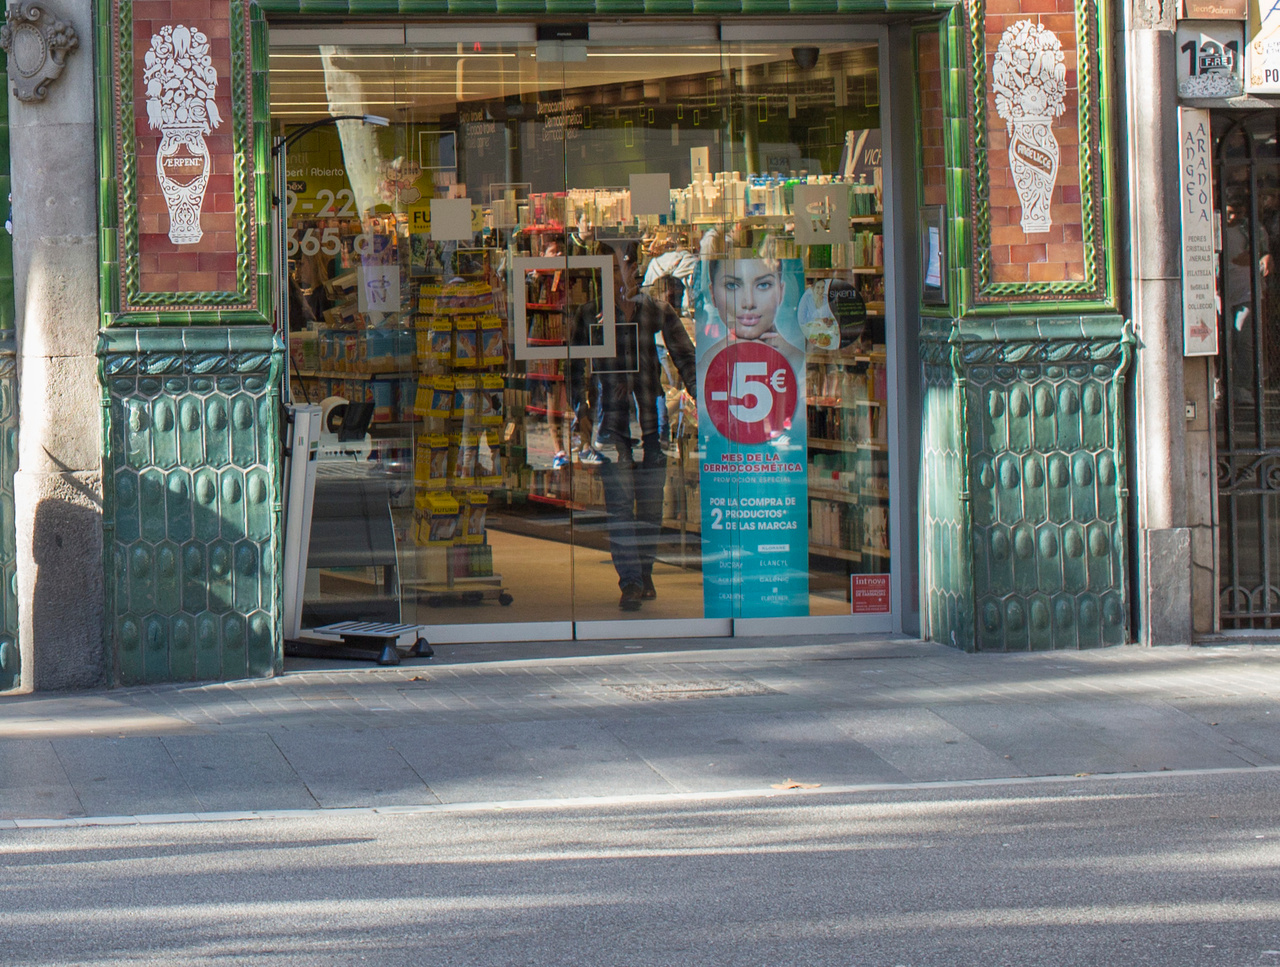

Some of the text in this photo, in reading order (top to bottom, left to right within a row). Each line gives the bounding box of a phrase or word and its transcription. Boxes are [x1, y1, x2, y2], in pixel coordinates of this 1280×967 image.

[311, 167, 344, 176] Abierto
[1185, 132, 1195, 214] ANGEL
[1195, 122, 1209, 222] ARANDA
[721, 453, 780, 462] MES DE LA
[703, 462, 803, 472] DERMOCOSMÉTICA
[710, 498, 796, 506] POR LA COMPRA DE
[710, 508, 723, 530] 2
[726, 521, 798, 530] DE LAS MARCAS
